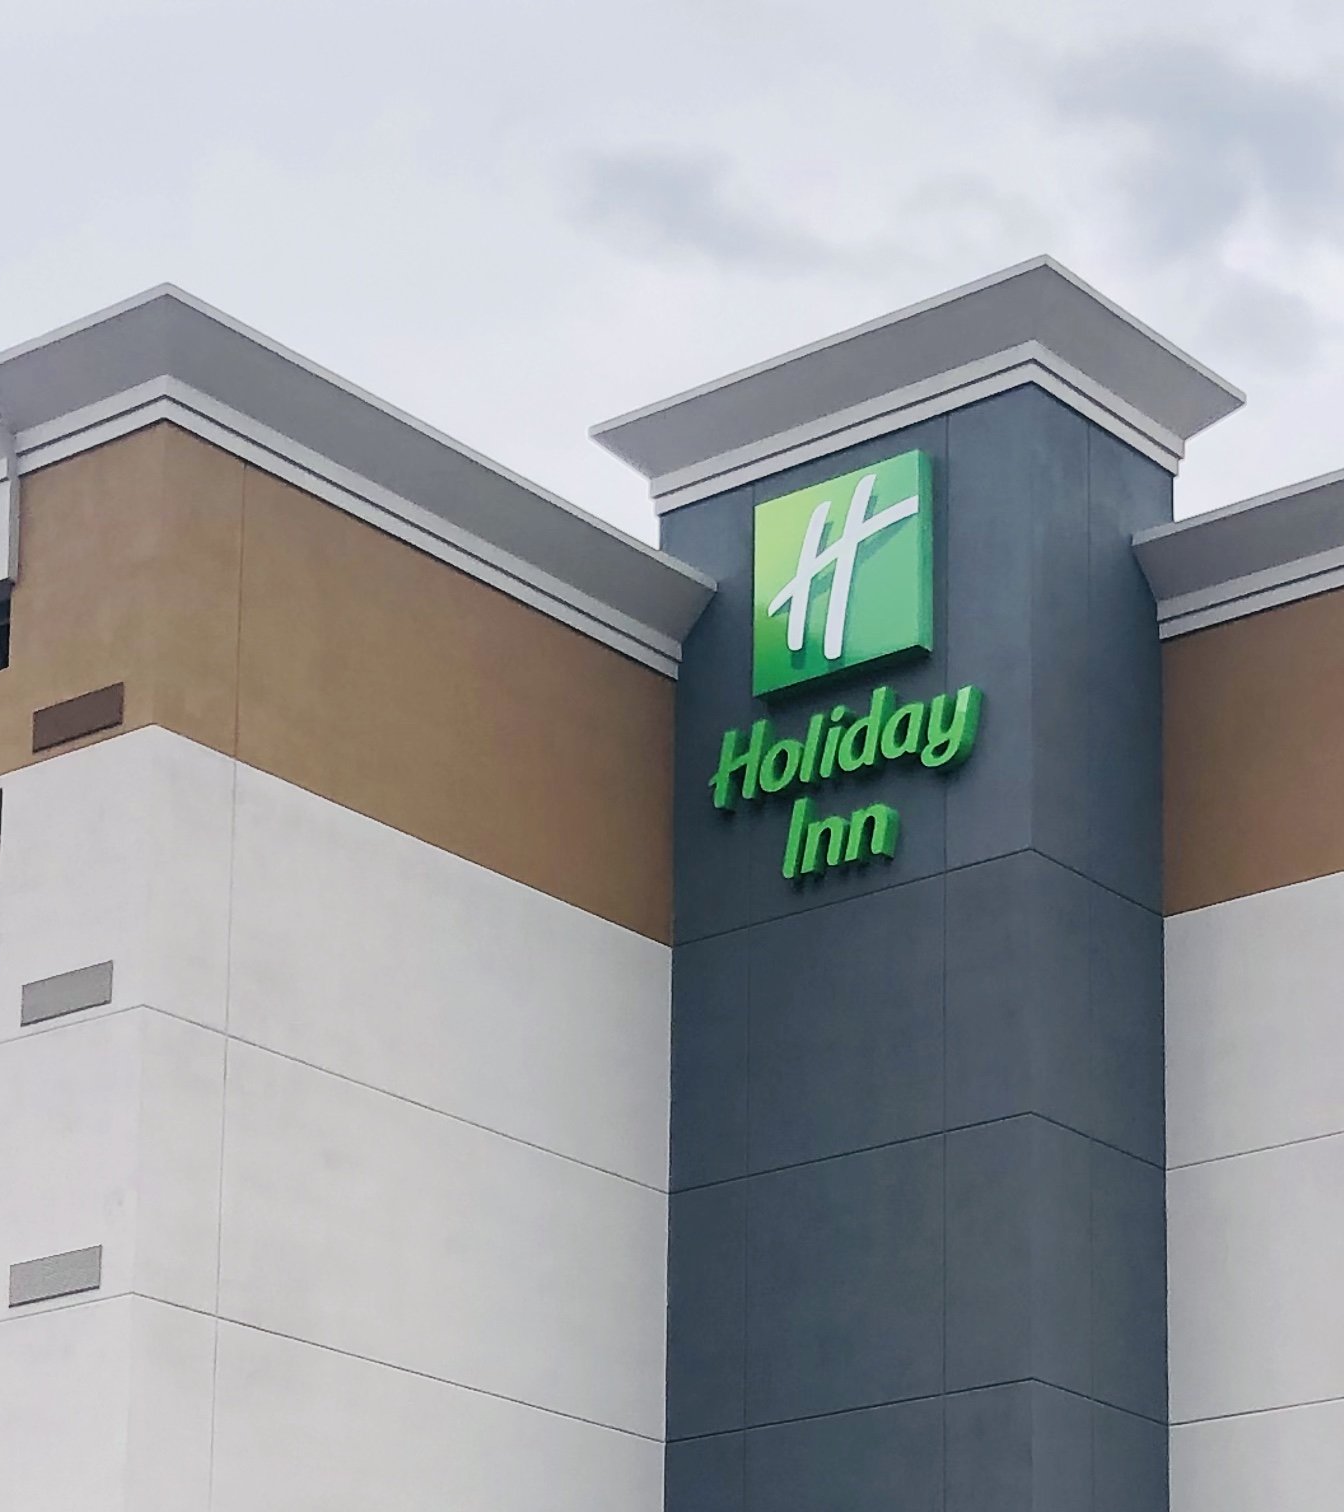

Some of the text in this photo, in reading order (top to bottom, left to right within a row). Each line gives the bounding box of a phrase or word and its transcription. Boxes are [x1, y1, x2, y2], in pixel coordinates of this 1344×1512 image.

[768, 474, 918, 659] H
[709, 686, 981, 808] Holiday
[783, 798, 899, 878] Inn
